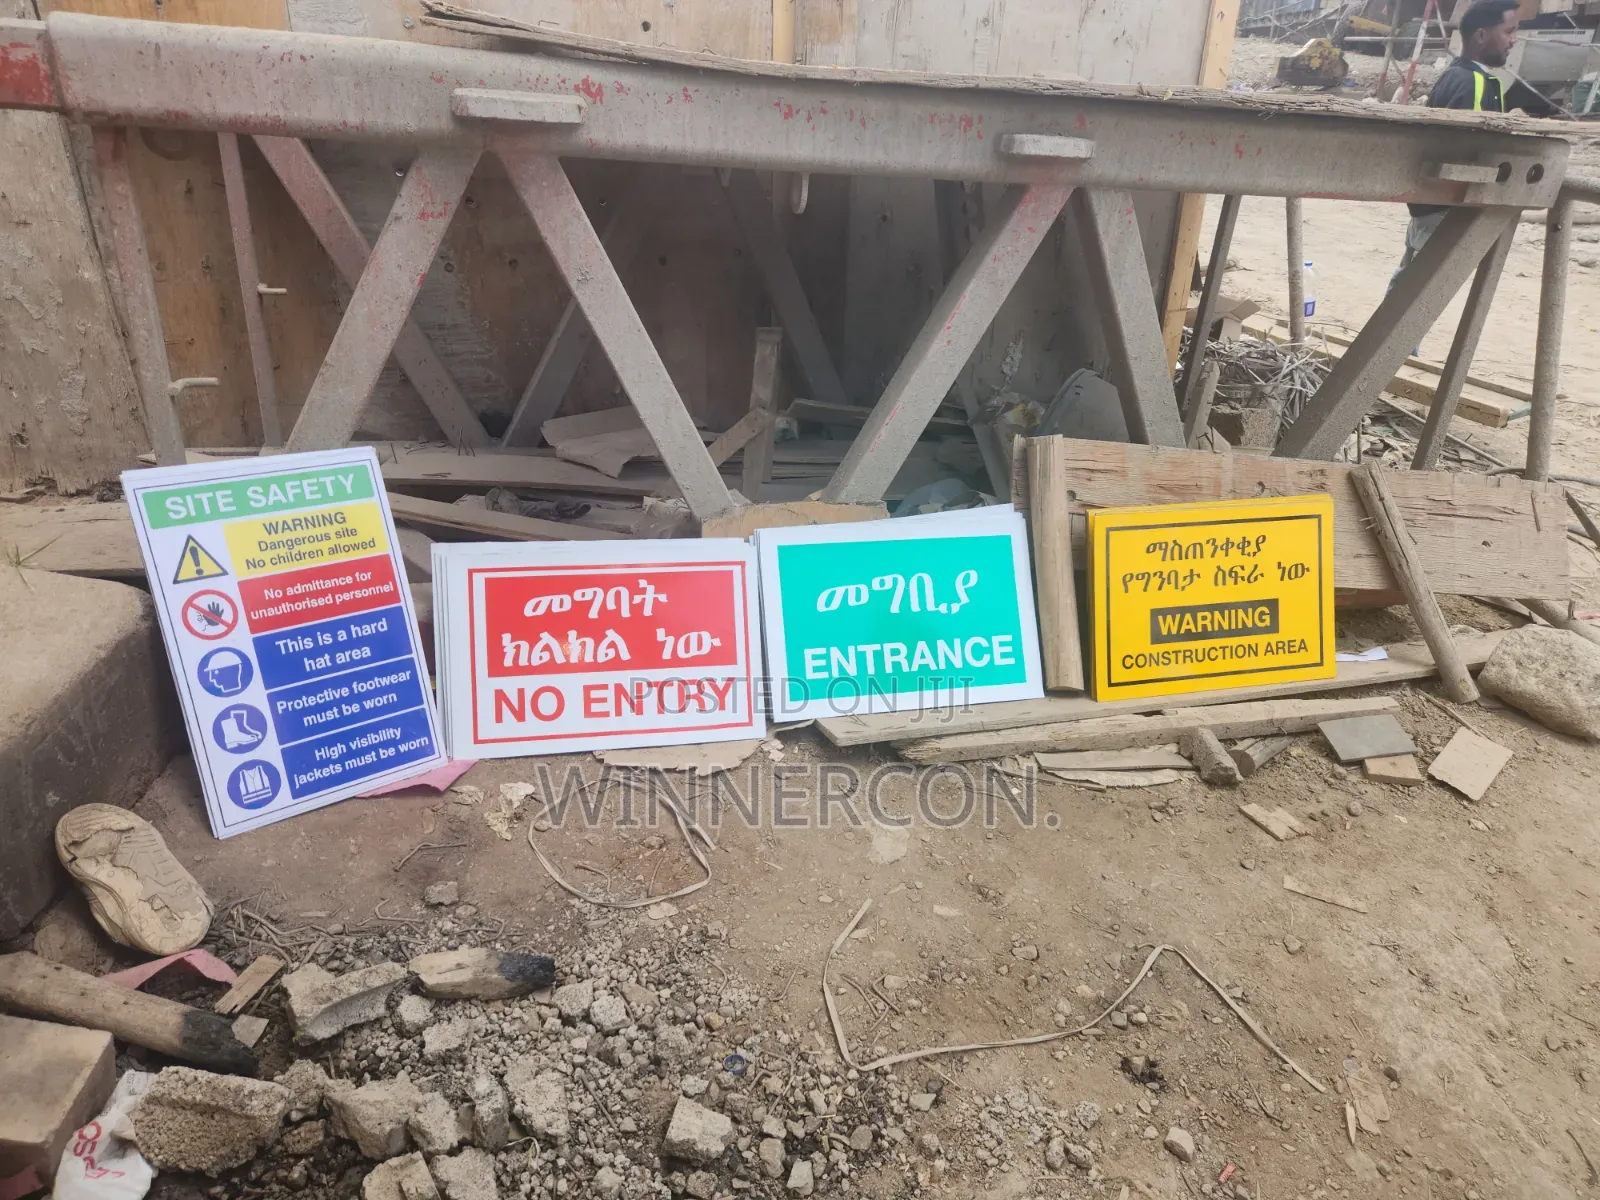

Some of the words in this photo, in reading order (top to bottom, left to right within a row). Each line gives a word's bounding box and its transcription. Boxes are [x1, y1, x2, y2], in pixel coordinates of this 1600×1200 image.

[165, 490, 237, 520] SITE
[247, 473, 354, 507] SAFETY
[258, 532, 331, 552] Dangerous
[335, 527, 358, 541] site
[262, 511, 346, 536] WARNING
[246, 557, 266, 570] No
[270, 546, 324, 566] children
[328, 538, 376, 556] allowed
[1146, 534, 1266, 561] ማስጠንቀቂያ
[264, 588, 283, 600] No
[286, 575, 353, 596] admittance
[355, 571, 372, 582] for
[816, 569, 978, 614] መግቢያ
[1122, 569, 1201, 593] የግንባታ
[1213, 564, 1264, 587] ስፍራ
[1277, 561, 1310, 581] ነው
[250, 594, 333, 619] unauthorised
[335, 581, 394, 605] personnel
[524, 579, 668, 619] መግባት
[275, 637, 314, 655] This
[317, 632, 332, 646] is
[337, 630, 347, 641] a
[350, 618, 388, 638] hard
[1158, 606, 1271, 636] WARNING
[304, 654, 332, 671] hat
[336, 646, 371, 664] area
[501, 628, 631, 667] ክልክል
[657, 628, 722, 660] ነው
[804, 635, 1016, 680] ENTRANCE
[1122, 643, 1259, 669] CONSTRUCTION
[1263, 639, 1308, 656] AREA
[277, 687, 349, 714] Protective
[352, 670, 411, 693] footwear
[303, 707, 339, 726] must
[342, 703, 360, 716] be
[363, 692, 397, 709] worn
[494, 685, 565, 724] NO
[583, 677, 735, 719] ENTRY
[315, 743, 347, 761] High
[349, 727, 401, 750] visibility
[294, 762, 342, 789] jackets
[345, 752, 377, 770] must
[379, 746, 395, 759] be
[398, 736, 428, 752] worn
